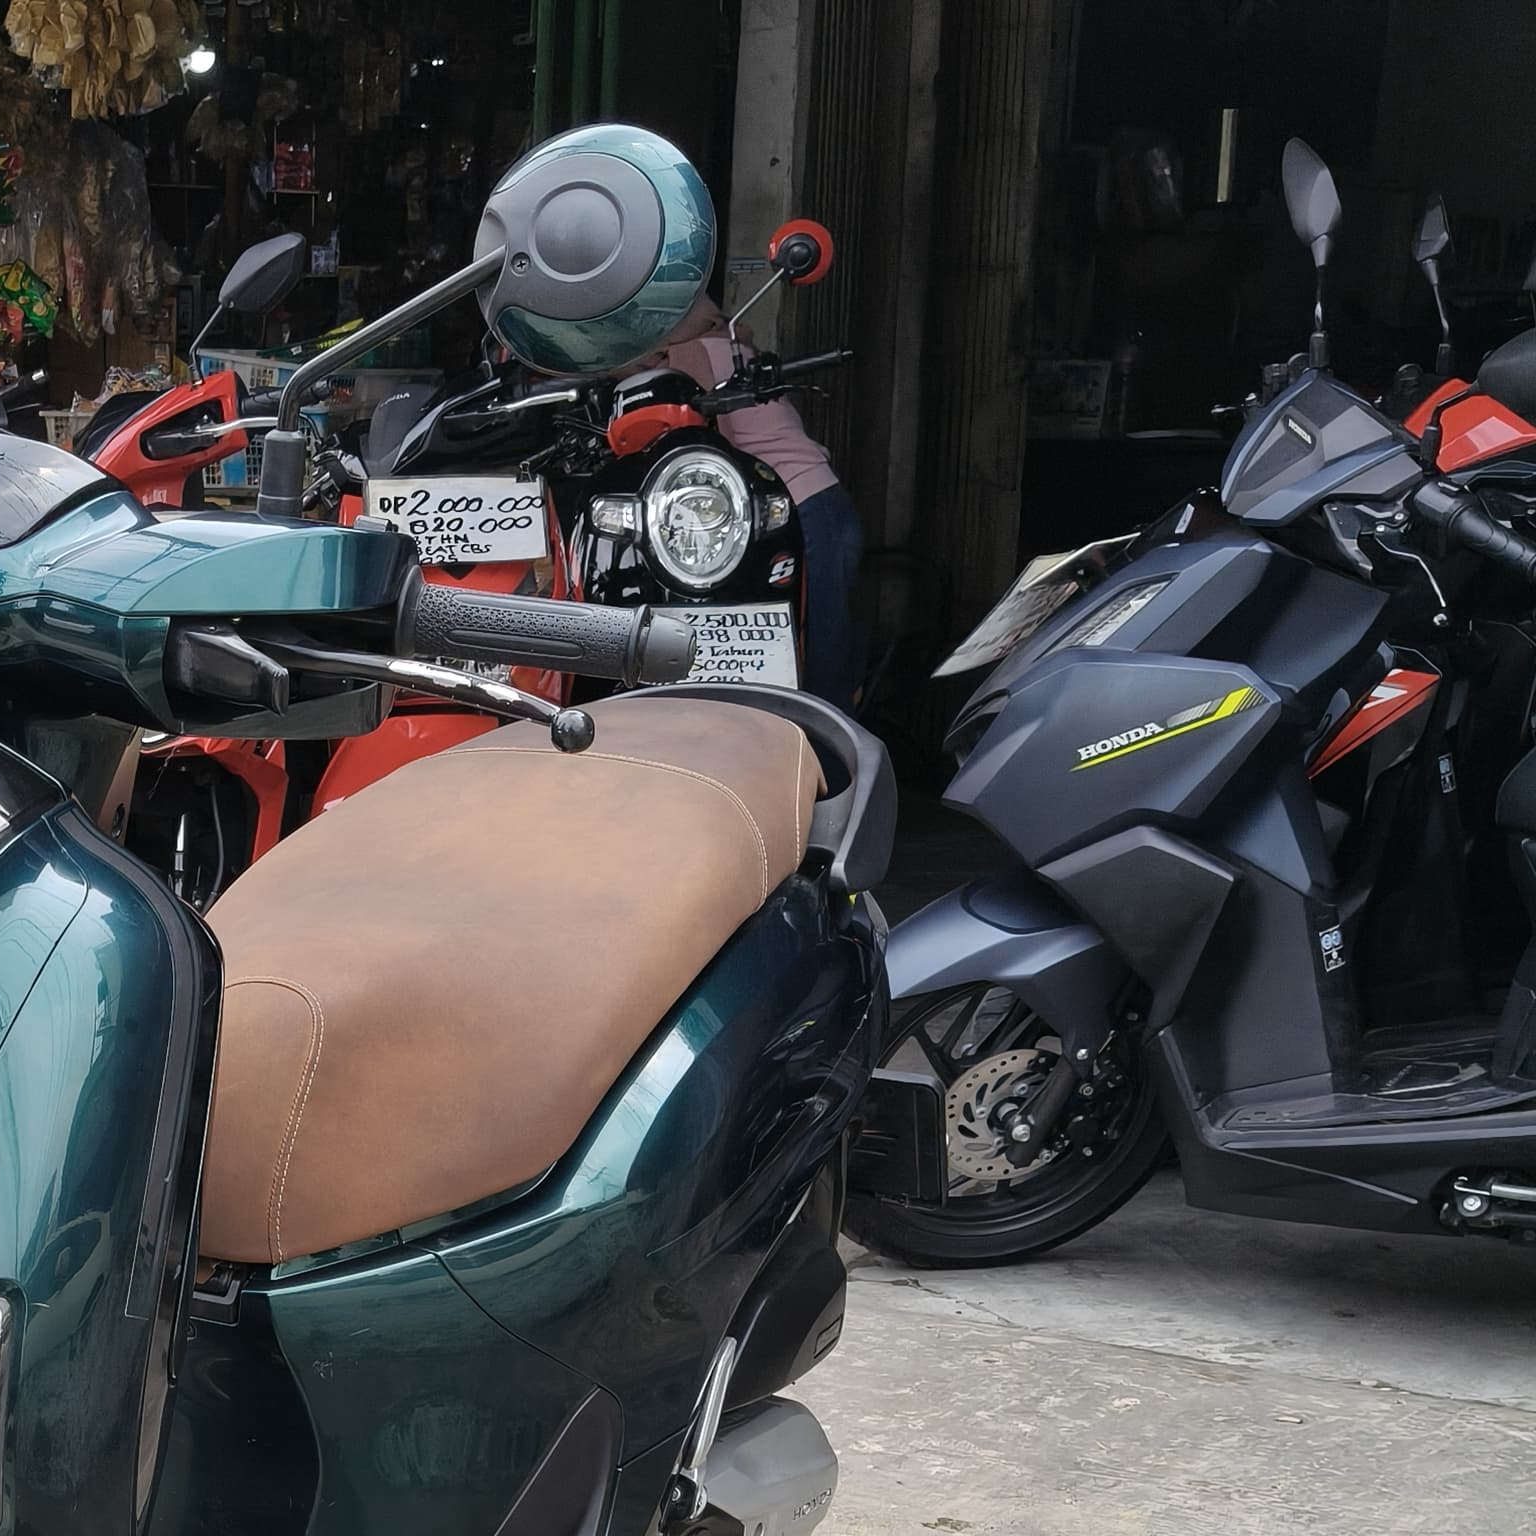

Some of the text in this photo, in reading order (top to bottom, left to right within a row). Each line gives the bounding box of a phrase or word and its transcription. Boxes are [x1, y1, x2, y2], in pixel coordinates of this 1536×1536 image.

[379, 490, 545, 516] DP 2.000.000
[460, 543, 492, 553] CBS
[1076, 722, 1165, 761] HONDA
